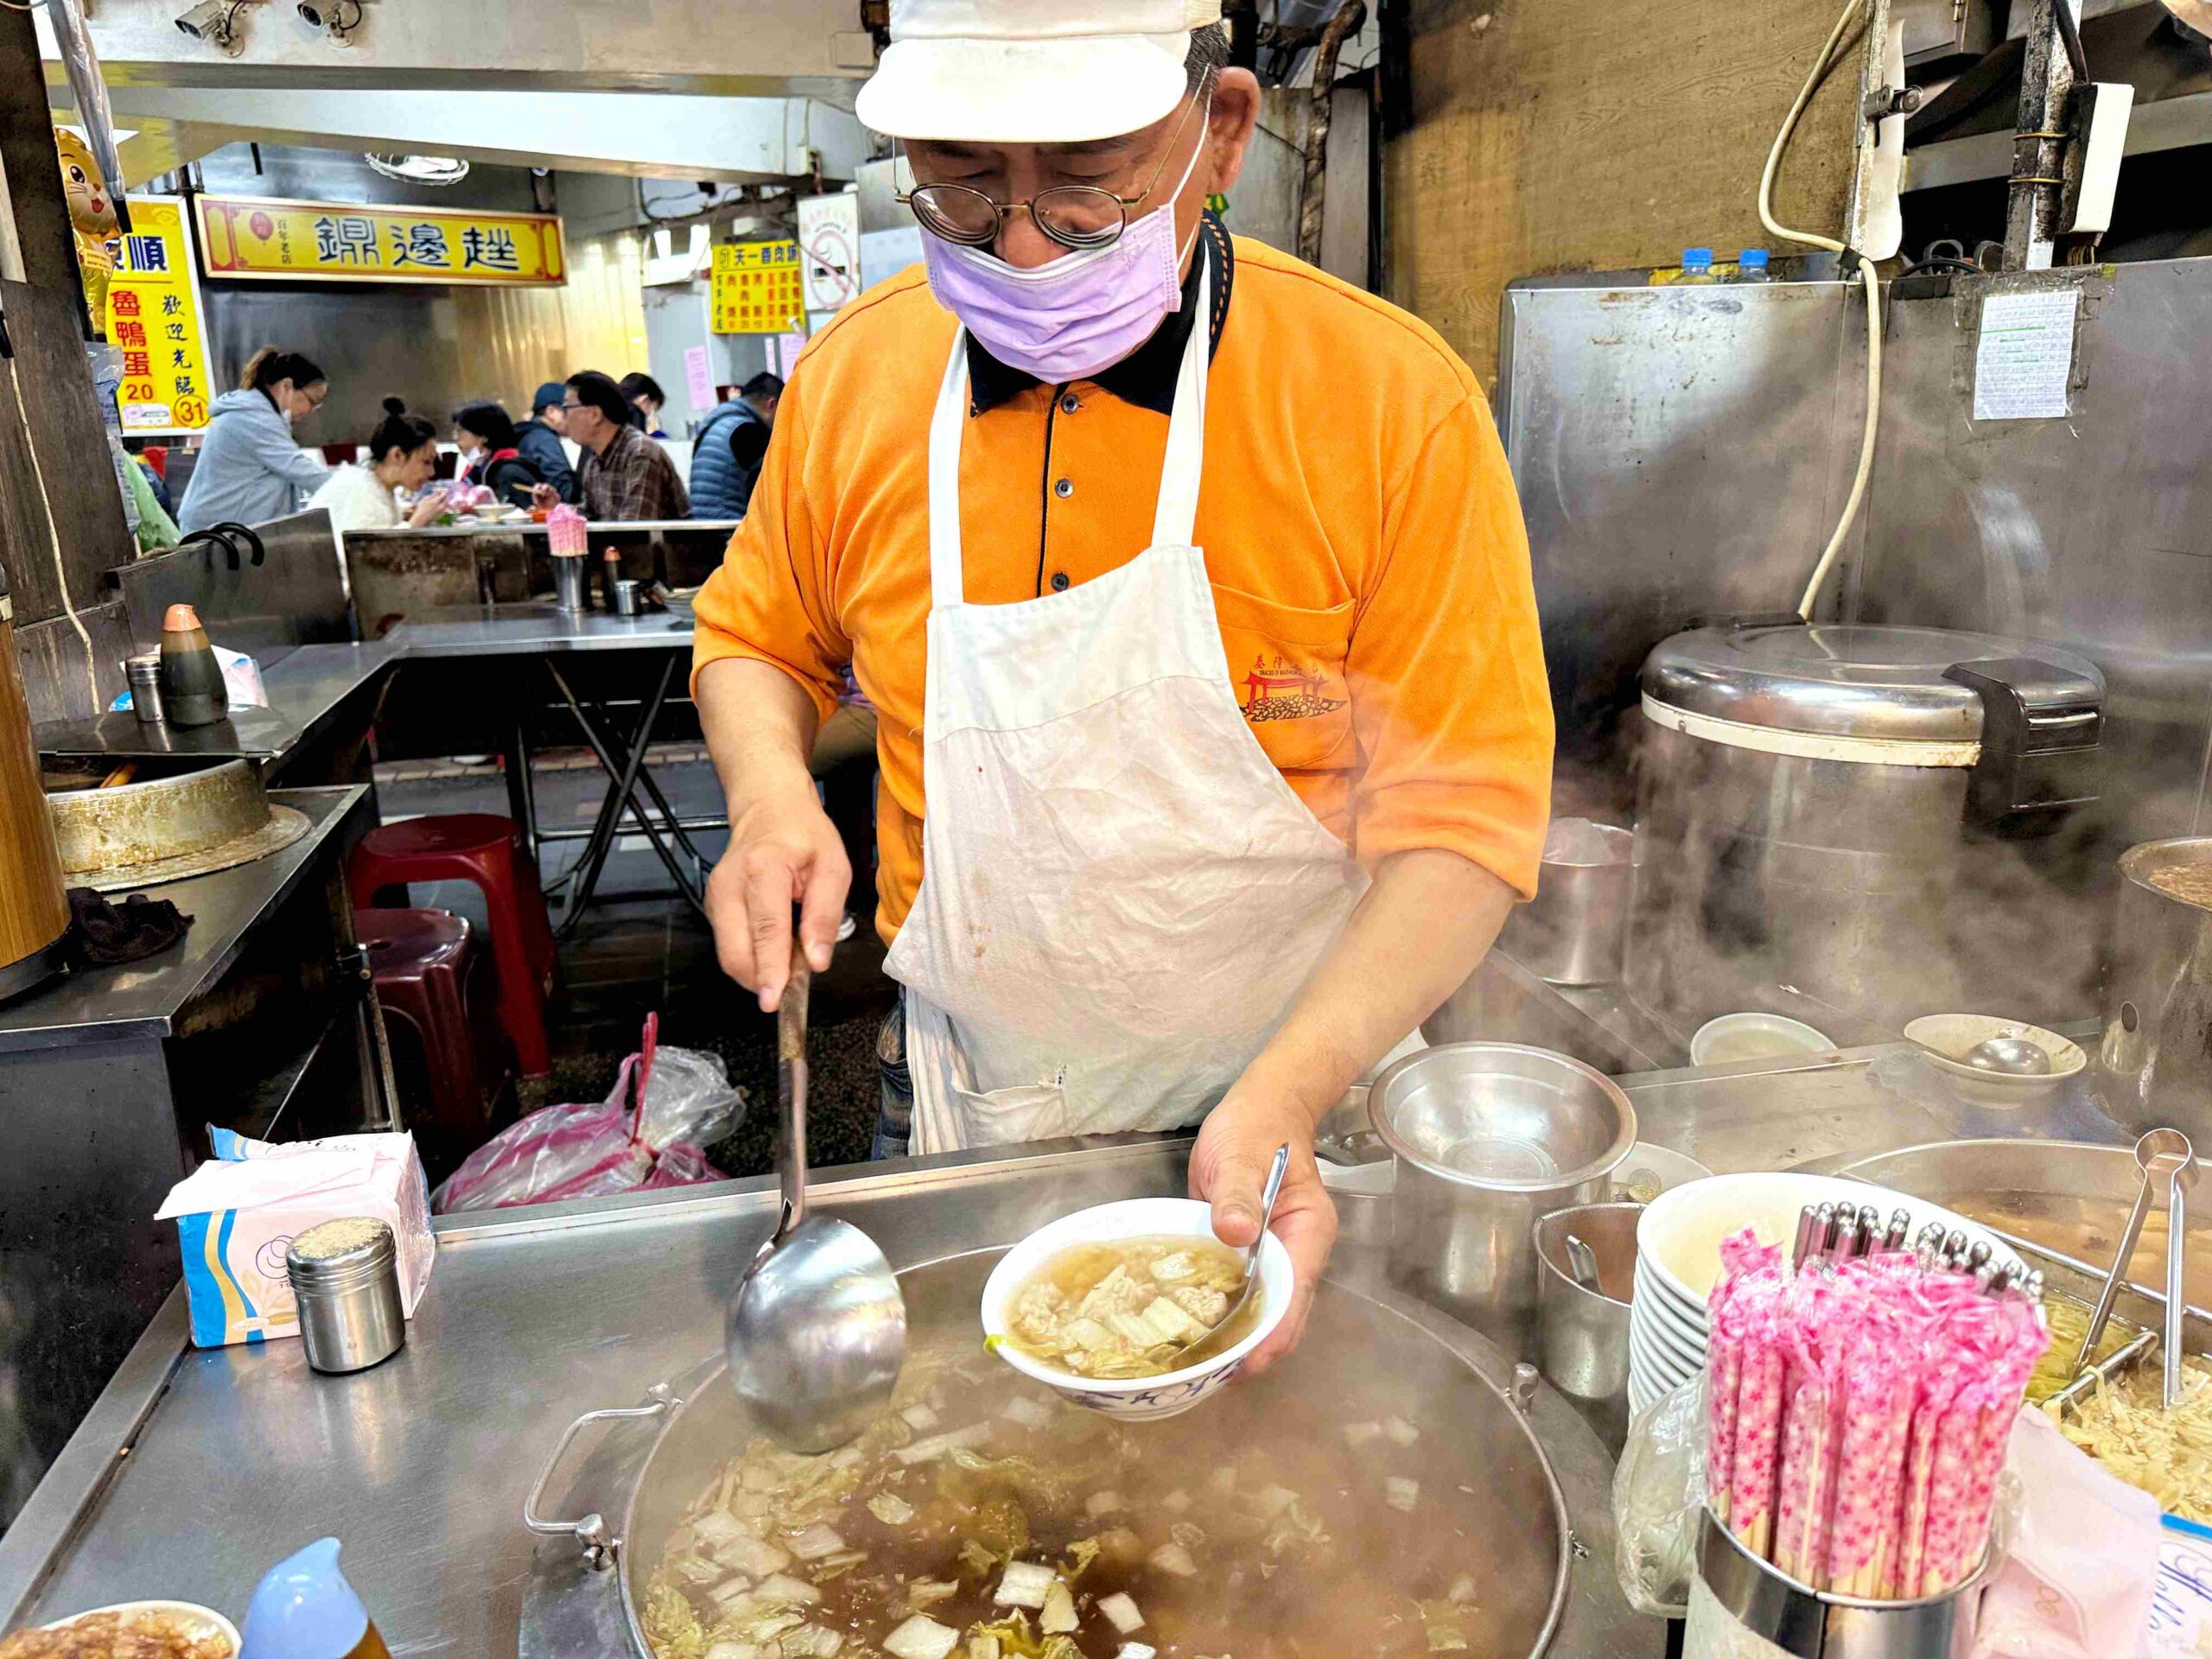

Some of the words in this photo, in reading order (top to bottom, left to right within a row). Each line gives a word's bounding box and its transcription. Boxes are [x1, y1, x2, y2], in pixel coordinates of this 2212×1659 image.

[111, 289, 153, 378] 魯鴨蛋
[162, 295, 195, 396] 歡迎光臨
[126, 384, 154, 401] 20
[179, 401, 206, 423] 31
